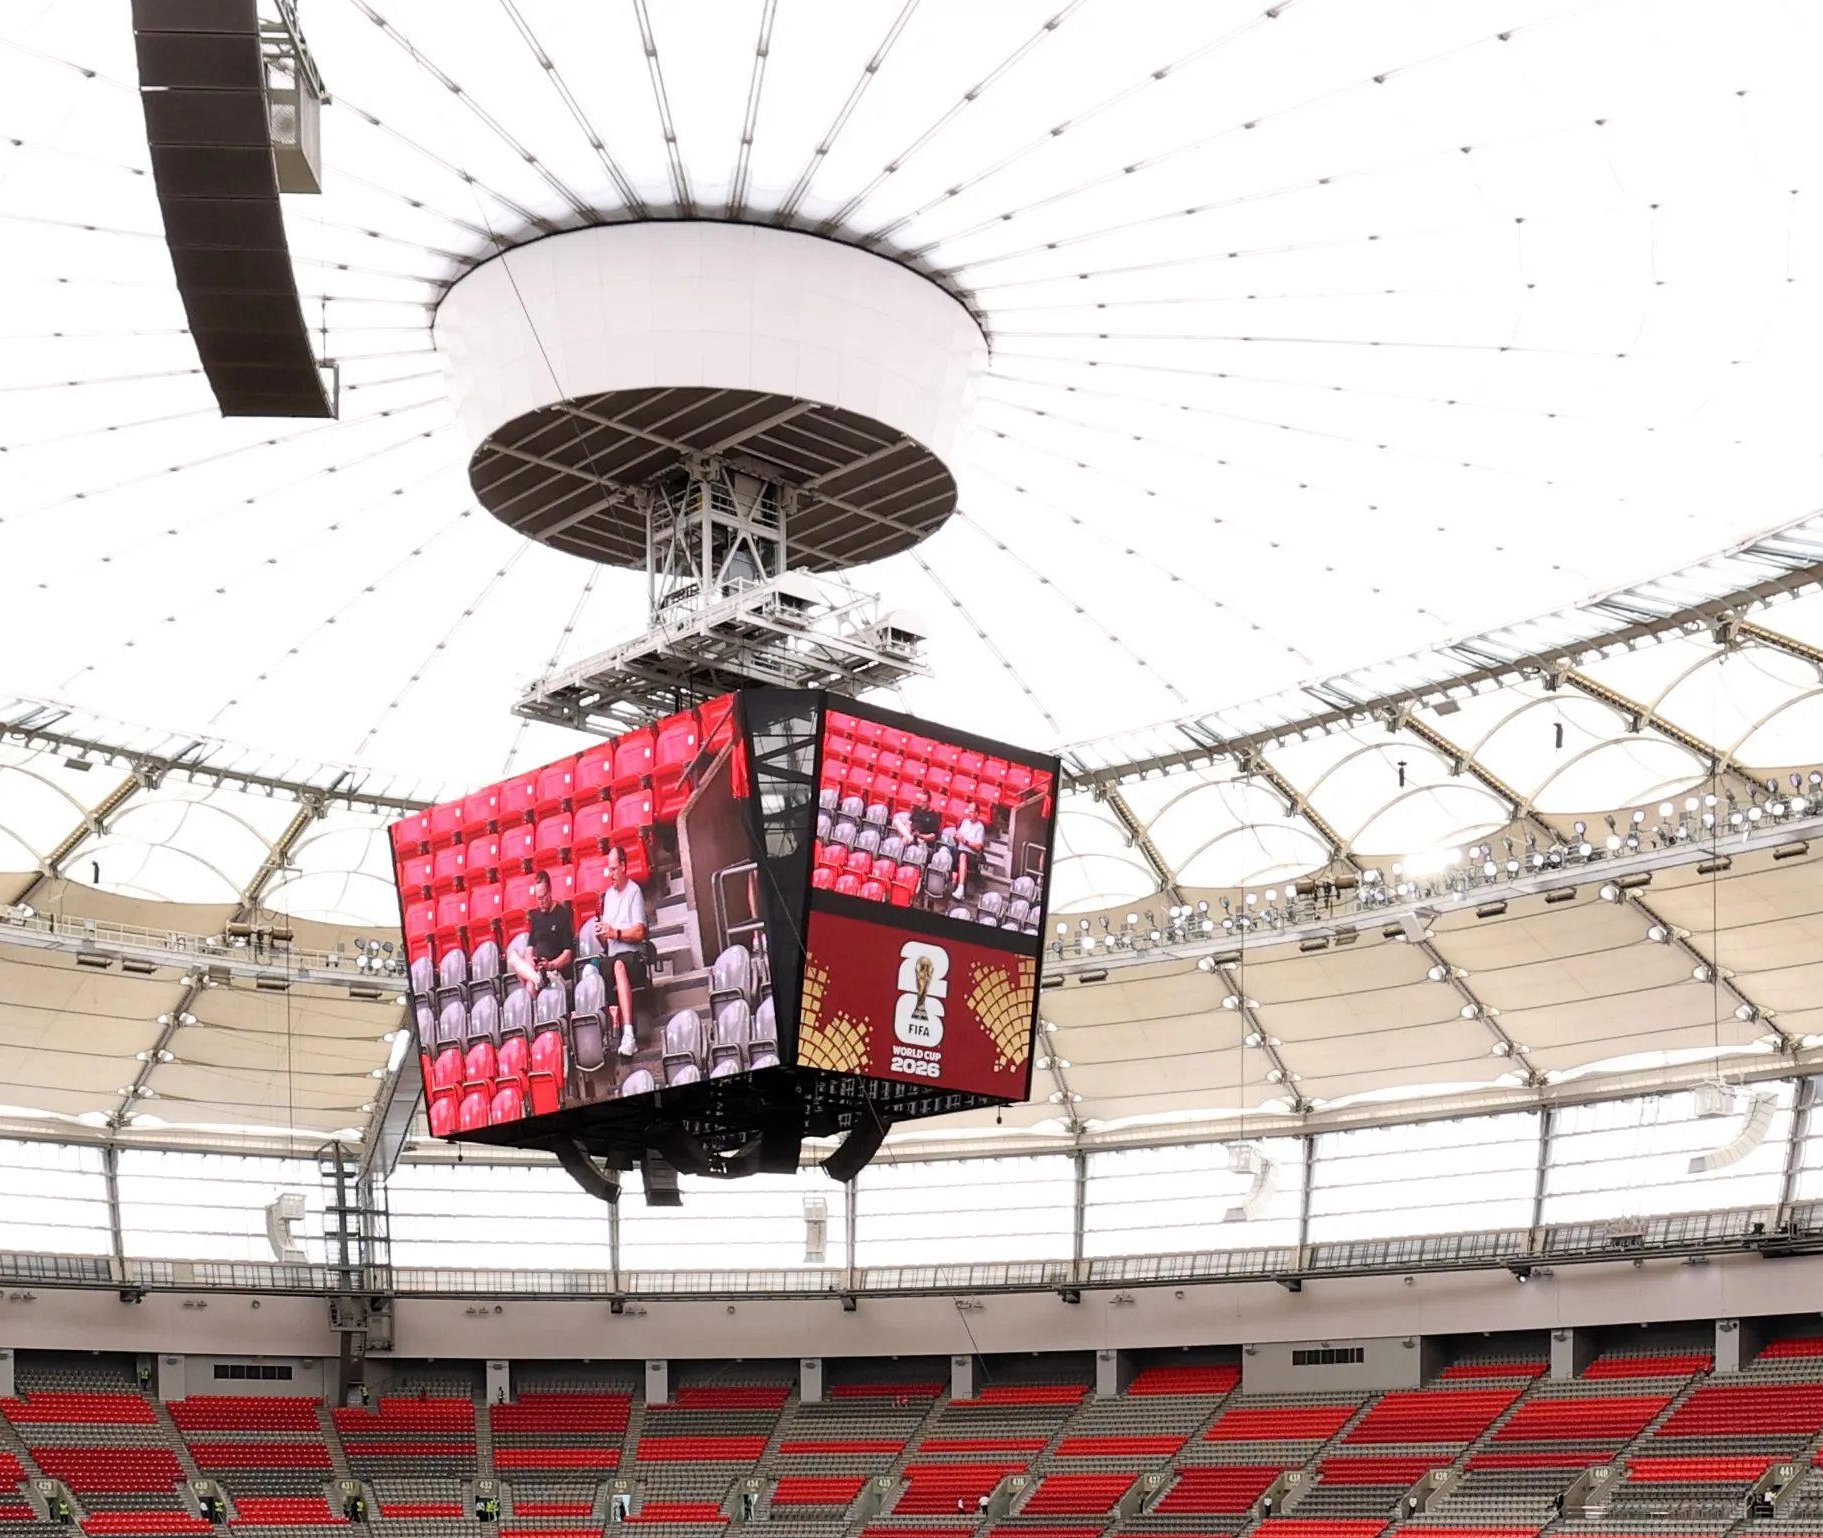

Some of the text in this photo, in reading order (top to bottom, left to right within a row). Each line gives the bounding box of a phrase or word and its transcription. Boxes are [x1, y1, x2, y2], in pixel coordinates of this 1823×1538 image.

[908, 1024, 930, 1037] FIFA
[892, 1045, 942, 1062] WORLD CUP
[890, 1056, 941, 1078] 2026
[1780, 1466, 1794, 1476] 441
[341, 1482, 354, 1490] 431
